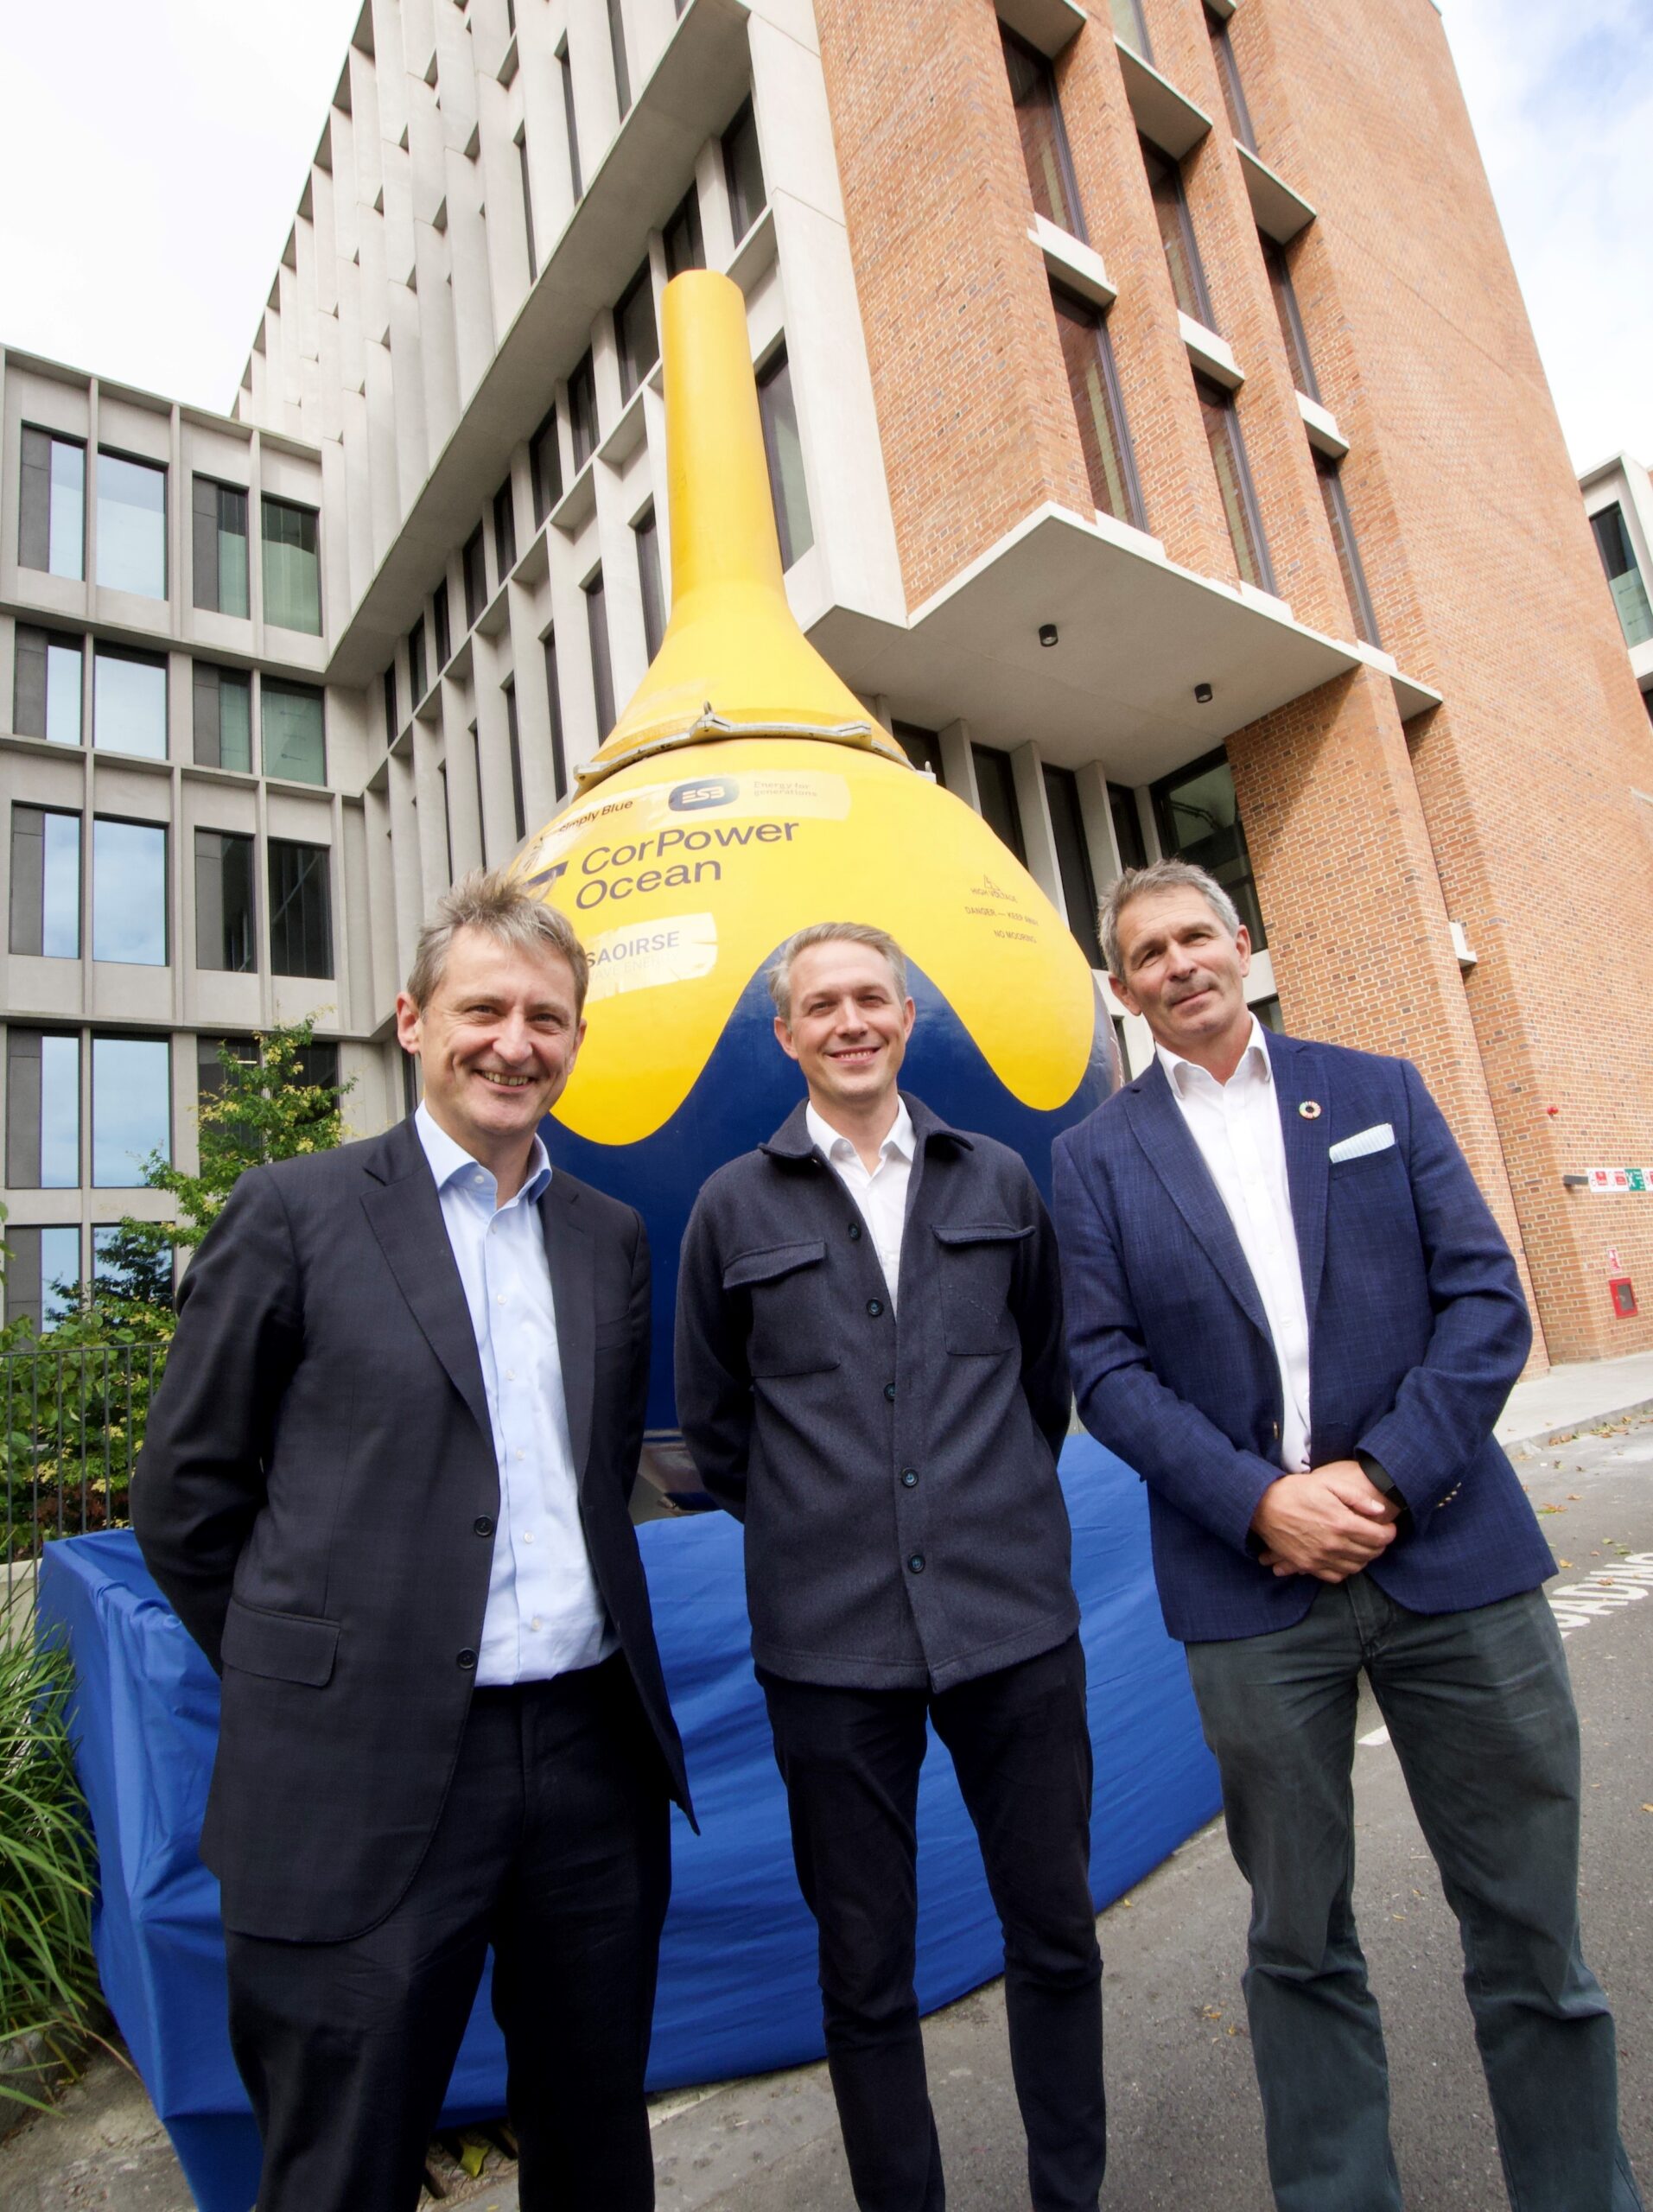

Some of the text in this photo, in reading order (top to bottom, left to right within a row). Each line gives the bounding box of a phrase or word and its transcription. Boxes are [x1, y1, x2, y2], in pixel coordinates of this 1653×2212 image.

[601, 800, 633, 816] Blue
[681, 785, 726, 804] ESB
[582, 822, 799, 875] CorPower
[575, 860, 722, 910] Ocean
[585, 931, 680, 969] SAOIRSE
